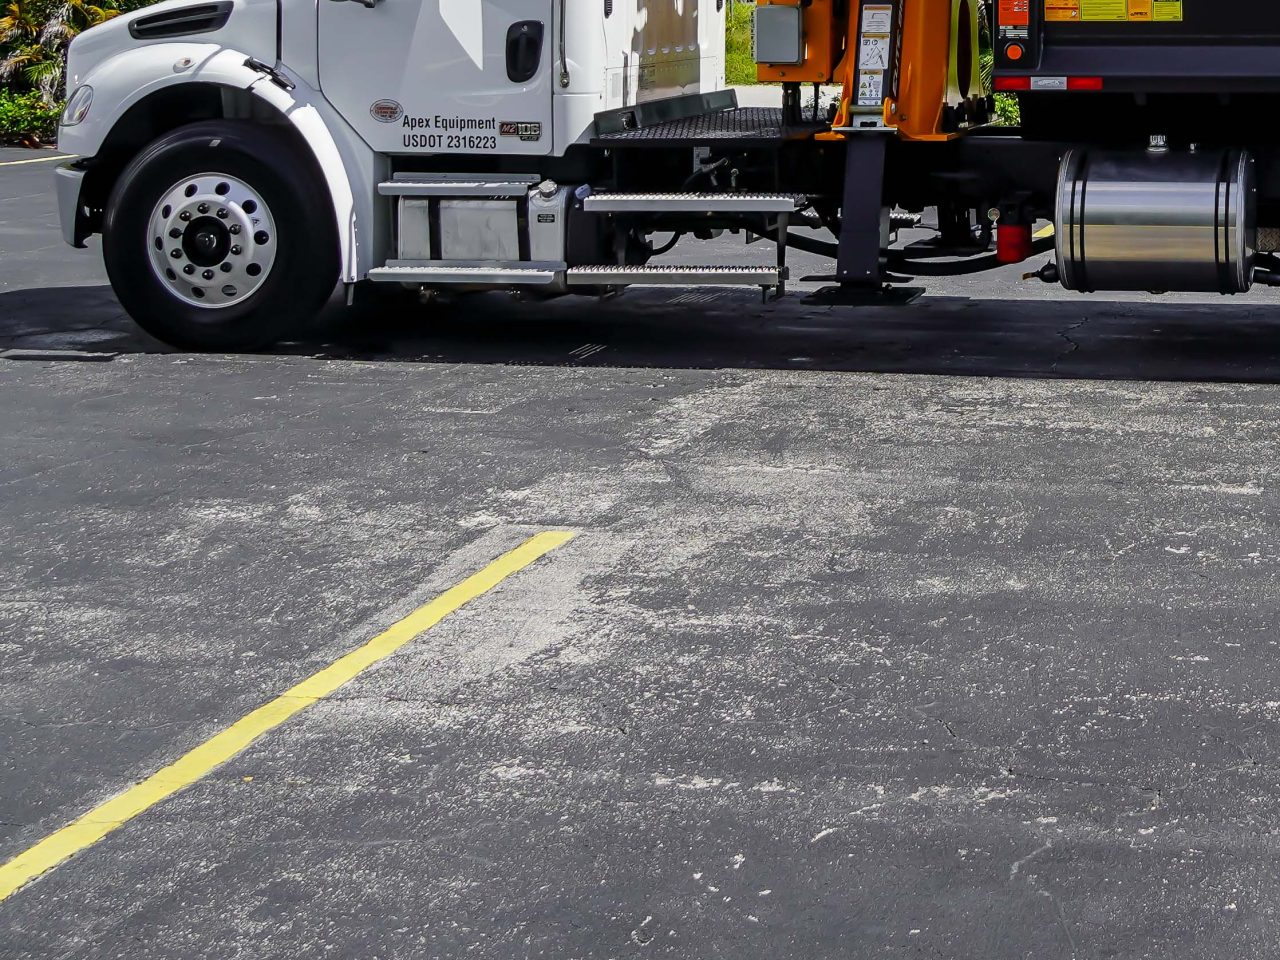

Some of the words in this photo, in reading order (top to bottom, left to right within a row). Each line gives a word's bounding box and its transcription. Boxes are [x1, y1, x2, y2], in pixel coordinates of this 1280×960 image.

[402, 114, 430, 131] Apex
[434, 115, 496, 131] Equipment
[518, 123, 540, 135] 106
[403, 135, 443, 148] USDOT
[447, 135, 497, 149] 2316223
